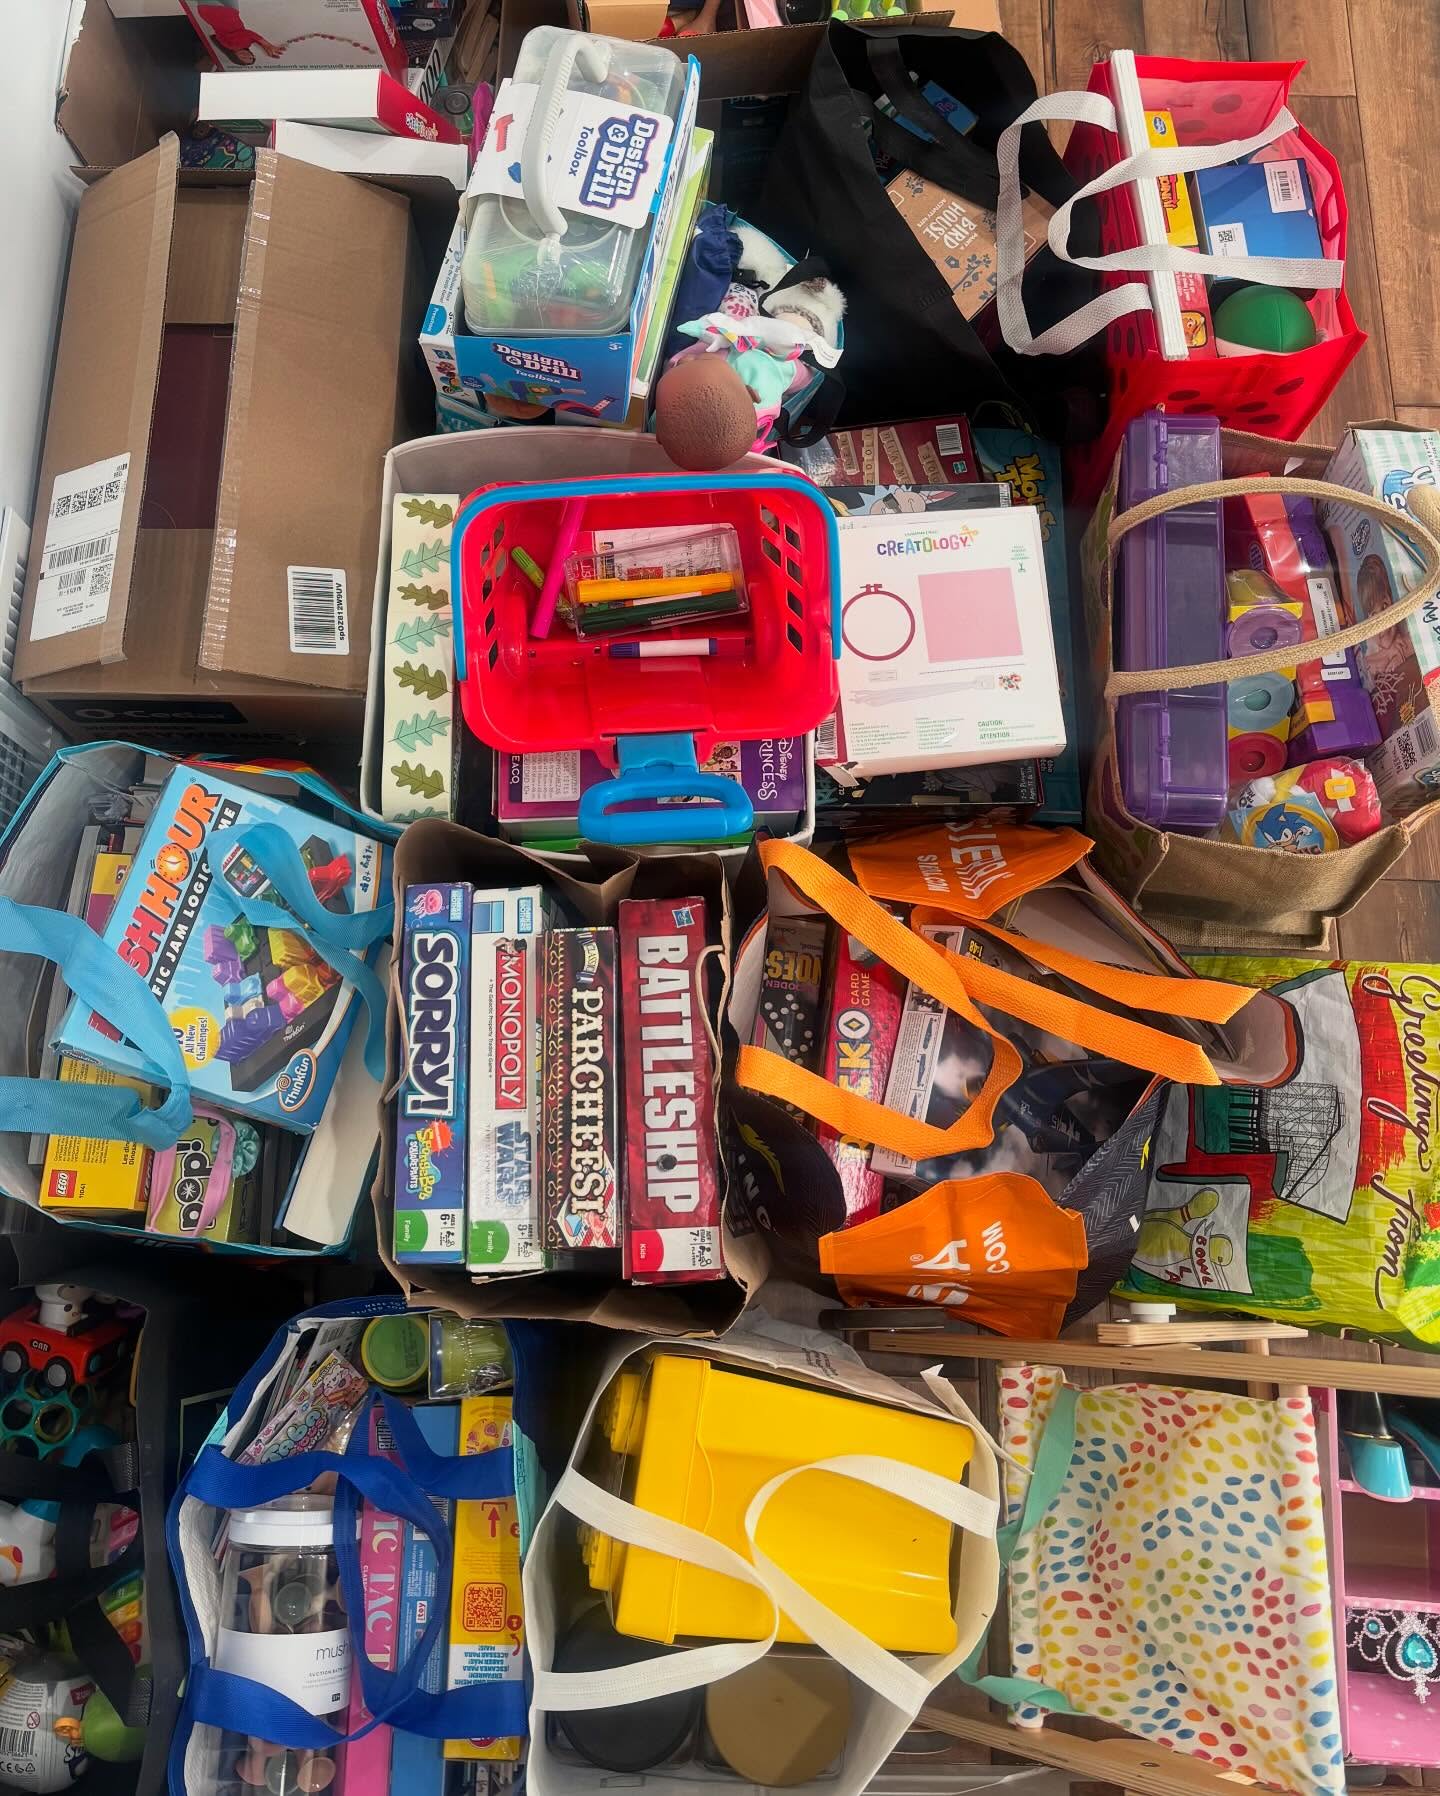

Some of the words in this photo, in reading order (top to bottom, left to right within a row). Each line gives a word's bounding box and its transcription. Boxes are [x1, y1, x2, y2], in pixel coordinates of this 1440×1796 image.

[568, 126, 595, 178] Toolbox
[615, 117, 658, 198] Design
[586, 141, 627, 209] Drill
[922, 201, 966, 243] HOUSE
[927, 199, 947, 221] ACTIVITY
[943, 216, 977, 249] BIRD
[496, 344, 566, 368] Design
[524, 358, 579, 379] Drill
[515, 369, 561, 384] Toolbox
[877, 533, 969, 557] CREATOLOGY
[1423, 601, 1438, 624] My
[511, 755, 520, 784] EACO
[757, 738, 777, 800] RINCESS
[775, 737, 794, 781] Disney
[166, 930, 189, 972] JAM
[181, 864, 213, 927] LOGIC
[219, 805, 236, 835] ME
[361, 869, 371, 884] 8+
[849, 976, 861, 1006] CARD
[860, 972, 872, 1007] GAME
[185, 1023, 196, 1036] New
[196, 1017, 209, 1061] Challenges!
[407, 933, 456, 1116] SORRY!
[499, 952, 524, 1104] MONOPOLY
[185, 1036, 195, 1053] All
[638, 935, 700, 1214] BATTLESHIP
[1361, 973, 1440, 1174] Greetings
[569, 986, 605, 1217] PARCHEESI
[495, 1122, 515, 1206] WARS
[514, 1121, 532, 1207] STAR
[55, 1172, 70, 1198] LEGO
[404, 1220, 412, 1243] Family
[440, 1214, 450, 1226] 6+
[690, 1230, 700, 1242] 7+
[486, 1230, 495, 1253] Family
[639, 1242, 647, 1260] Kids
[1371, 1172, 1421, 1312] from
[1195, 1234, 1213, 1286] BOWL
[32, 1341, 49, 1351] CAR
[366, 1571, 396, 1641] TAC
